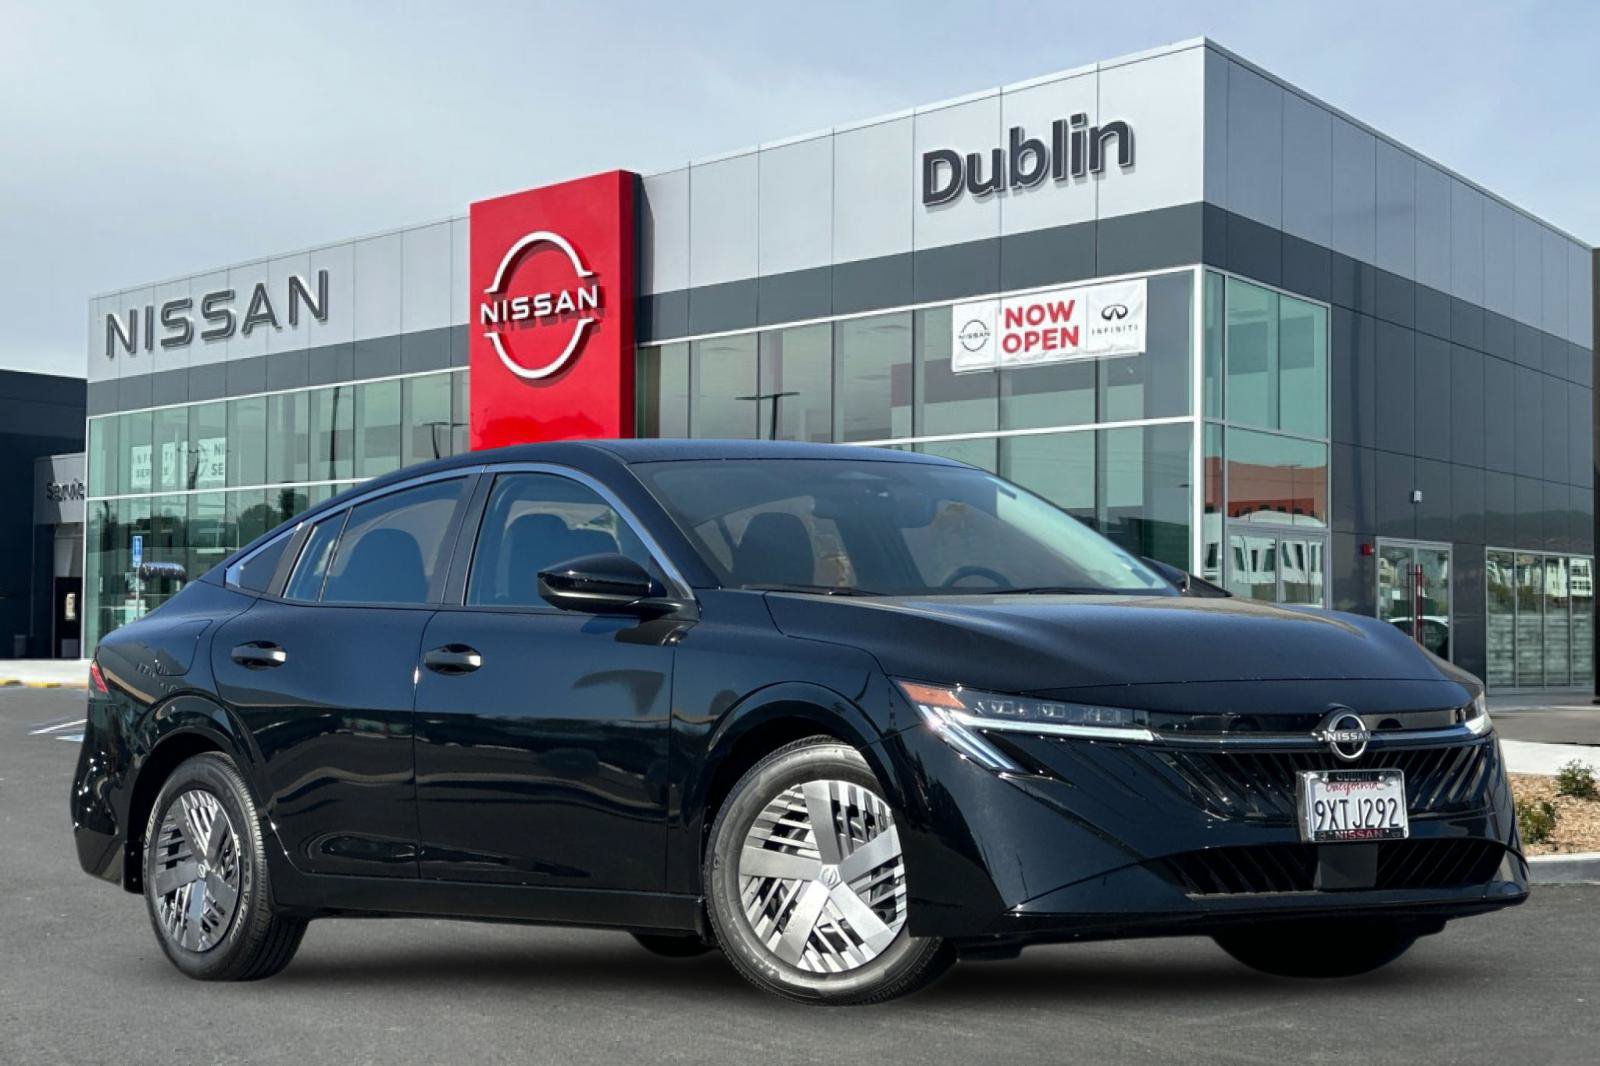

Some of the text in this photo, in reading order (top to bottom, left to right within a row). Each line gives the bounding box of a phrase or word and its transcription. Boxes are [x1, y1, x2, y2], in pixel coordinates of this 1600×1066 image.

[922, 112, 1135, 207] Dublin
[105, 269, 329, 359] NISSAN
[480, 285, 598, 326] NISSAN
[1005, 299, 1076, 329] NOW
[958, 331, 991, 340] NISSAN
[1002, 325, 1079, 353] OPEN
[1091, 324, 1138, 336] INFINITI
[1327, 731, 1371, 741] NISSAN
[1315, 798, 1399, 830] 9XTJ292
[1335, 829, 1384, 840] NISSAN
